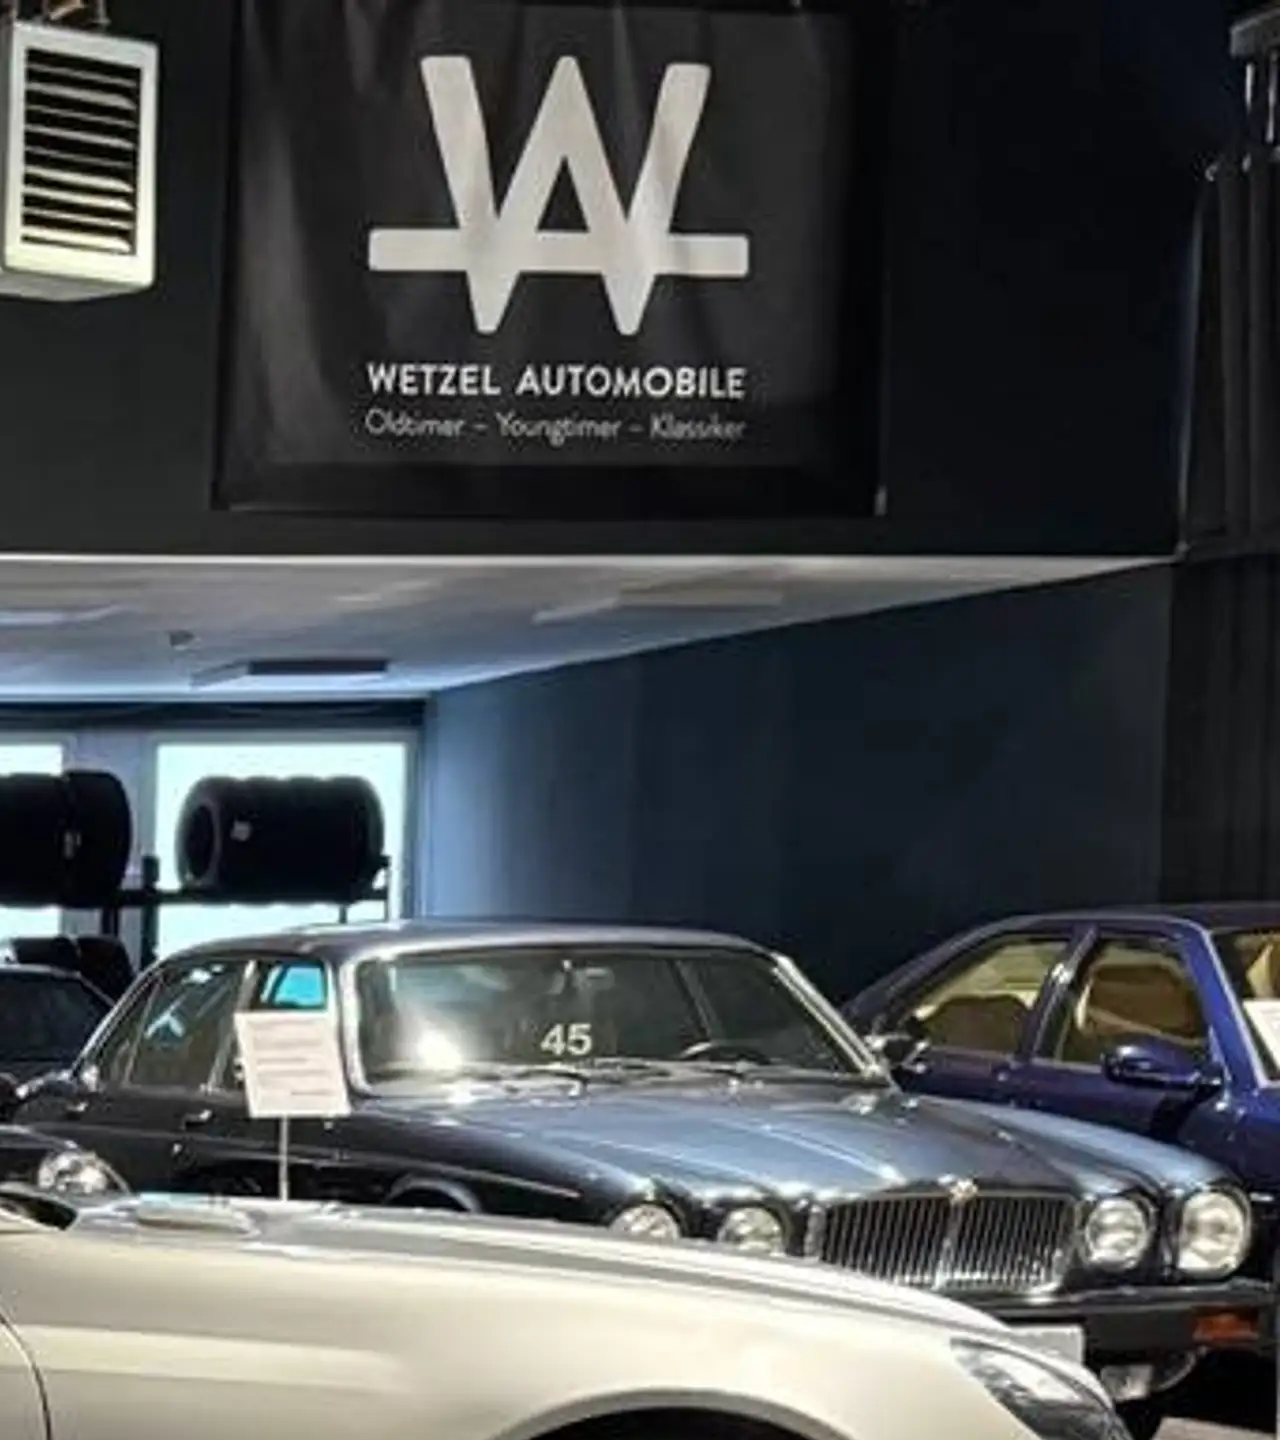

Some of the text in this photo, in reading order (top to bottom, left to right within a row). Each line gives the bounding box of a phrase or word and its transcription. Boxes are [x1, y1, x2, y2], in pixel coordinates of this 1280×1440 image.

[367, 362, 748, 400] WETZEL AUTOMOBILE
[365, 408, 466, 438] Oldtimer
[495, 409, 622, 448] Youngtimer
[650, 412, 747, 441] Klassiker
[540, 1022, 592, 1056] 45
